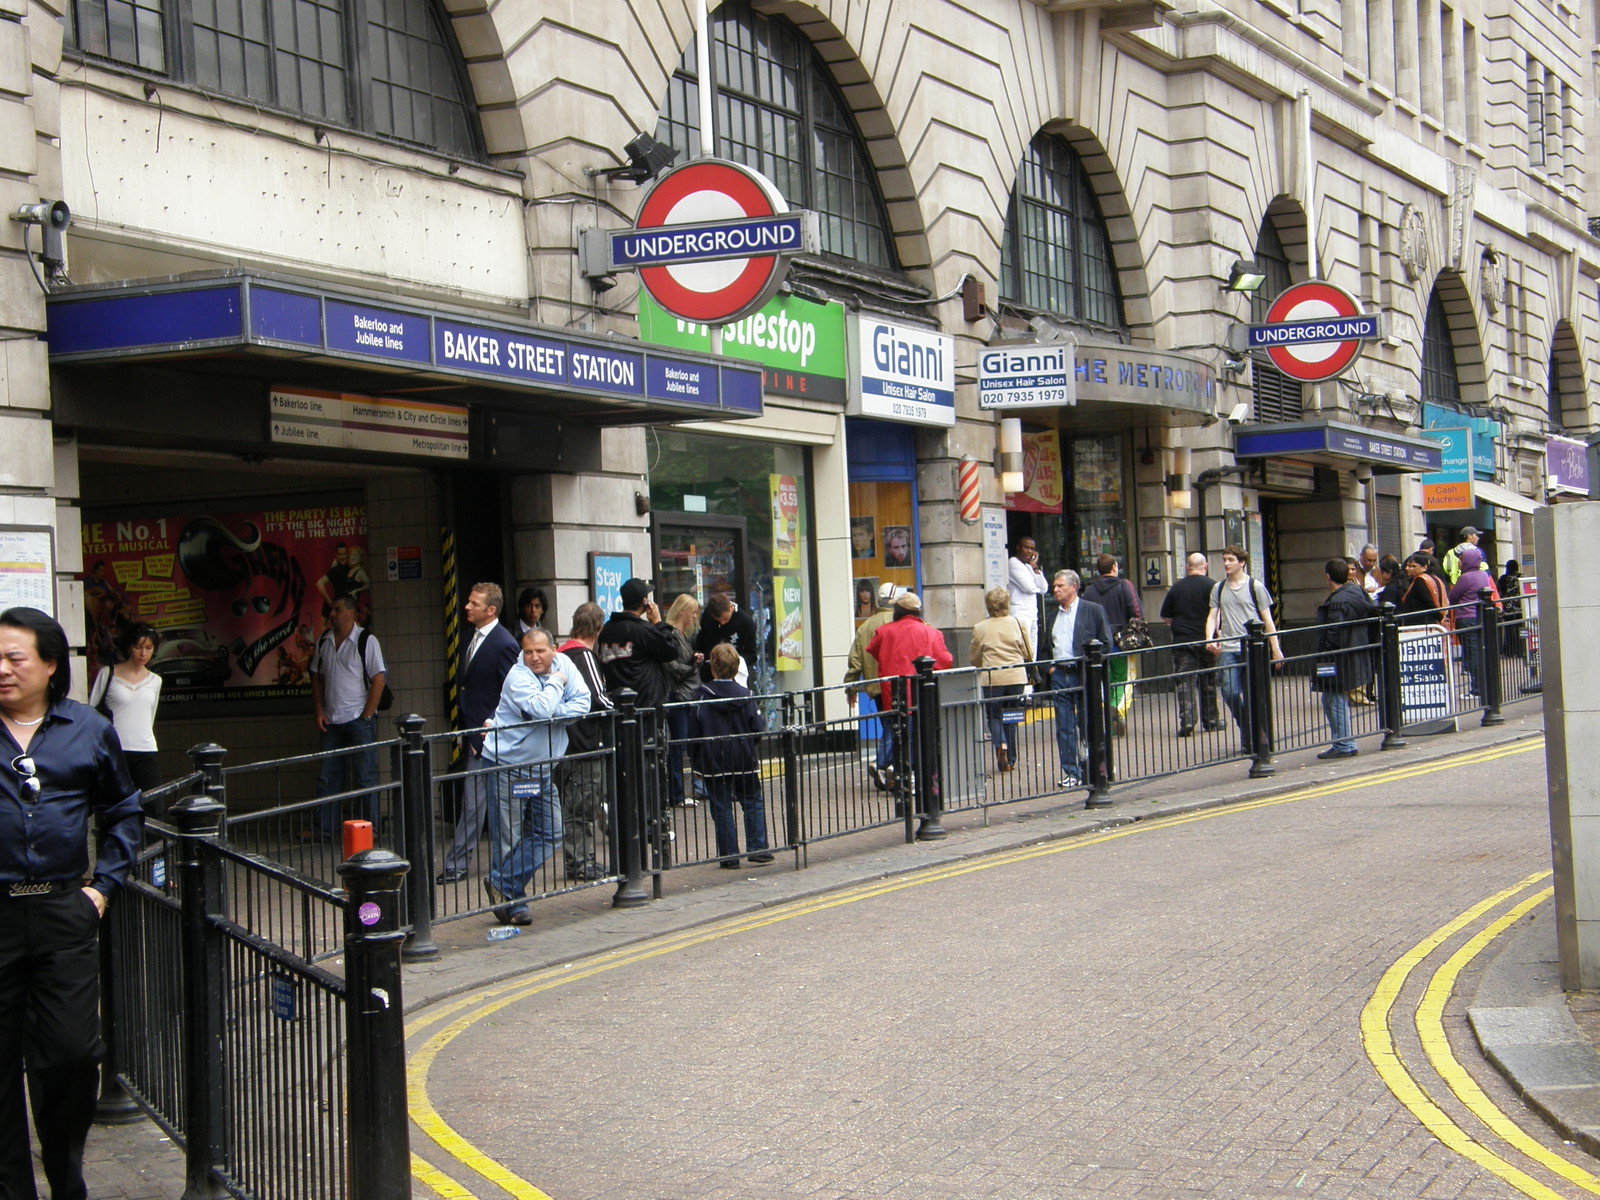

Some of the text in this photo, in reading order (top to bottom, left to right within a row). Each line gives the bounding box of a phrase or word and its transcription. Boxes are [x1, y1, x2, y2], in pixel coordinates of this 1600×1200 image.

[624, 224, 796, 258] UNDERGROUND
[354, 315, 403, 335] Bakerloo and
[1255, 322, 1371, 342] UNDERGROUND
[355, 331, 403, 350] Jubilee lines
[676, 309, 816, 367] stlestop
[443, 330, 634, 386] BAKER STREET STATION
[873, 324, 943, 382] Gianni
[982, 349, 1064, 374] Gianni
[665, 367, 699, 383] Bakerloo and
[1074, 357, 1108, 384] HE
[666, 380, 699, 395] Jubilee lines
[982, 376, 1065, 389] Unisex Hair Salon
[882, 381, 935, 403] Unisex Hair Salon
[983, 389, 1065, 404] 020 7935 1979
[279, 397, 323, 412] Bakerloo line
[892, 403, 927, 418] 020 7935 1979
[352, 404, 462, 427] Hammersmith & City and Circle lines
[280, 427, 319, 439] Jubilee line
[412, 439, 462, 453] Metropolitan line
[1369, 441, 1380, 454] BAKER
[1381, 444, 1393, 457] STREET
[1393, 446, 1406, 459] STATION
[1436, 485, 1457, 494] Cash
[1427, 495, 1466, 504] Machines
[264, 506, 367, 522] THE PARTY IS BAC
[81, 518, 168, 544] HE No.1
[266, 522, 284, 532] IT'S
[286, 520, 305, 531] THE
[307, 519, 324, 529] BIG
[326, 517, 357, 528] NIGHT
[294, 528, 305, 539] IN
[308, 528, 327, 538] THE
[328, 526, 356, 537] WEST
[81, 540, 170, 554] ATEST MUSICAL
[596, 566, 622, 592] Stay
[783, 588, 801, 602] NEW
[268, 620, 293, 645] word
[159, 693, 194, 702] ICCADILLY
[244, 690, 267, 698] OFFICE
[9, 880, 53, 897] Gucci
